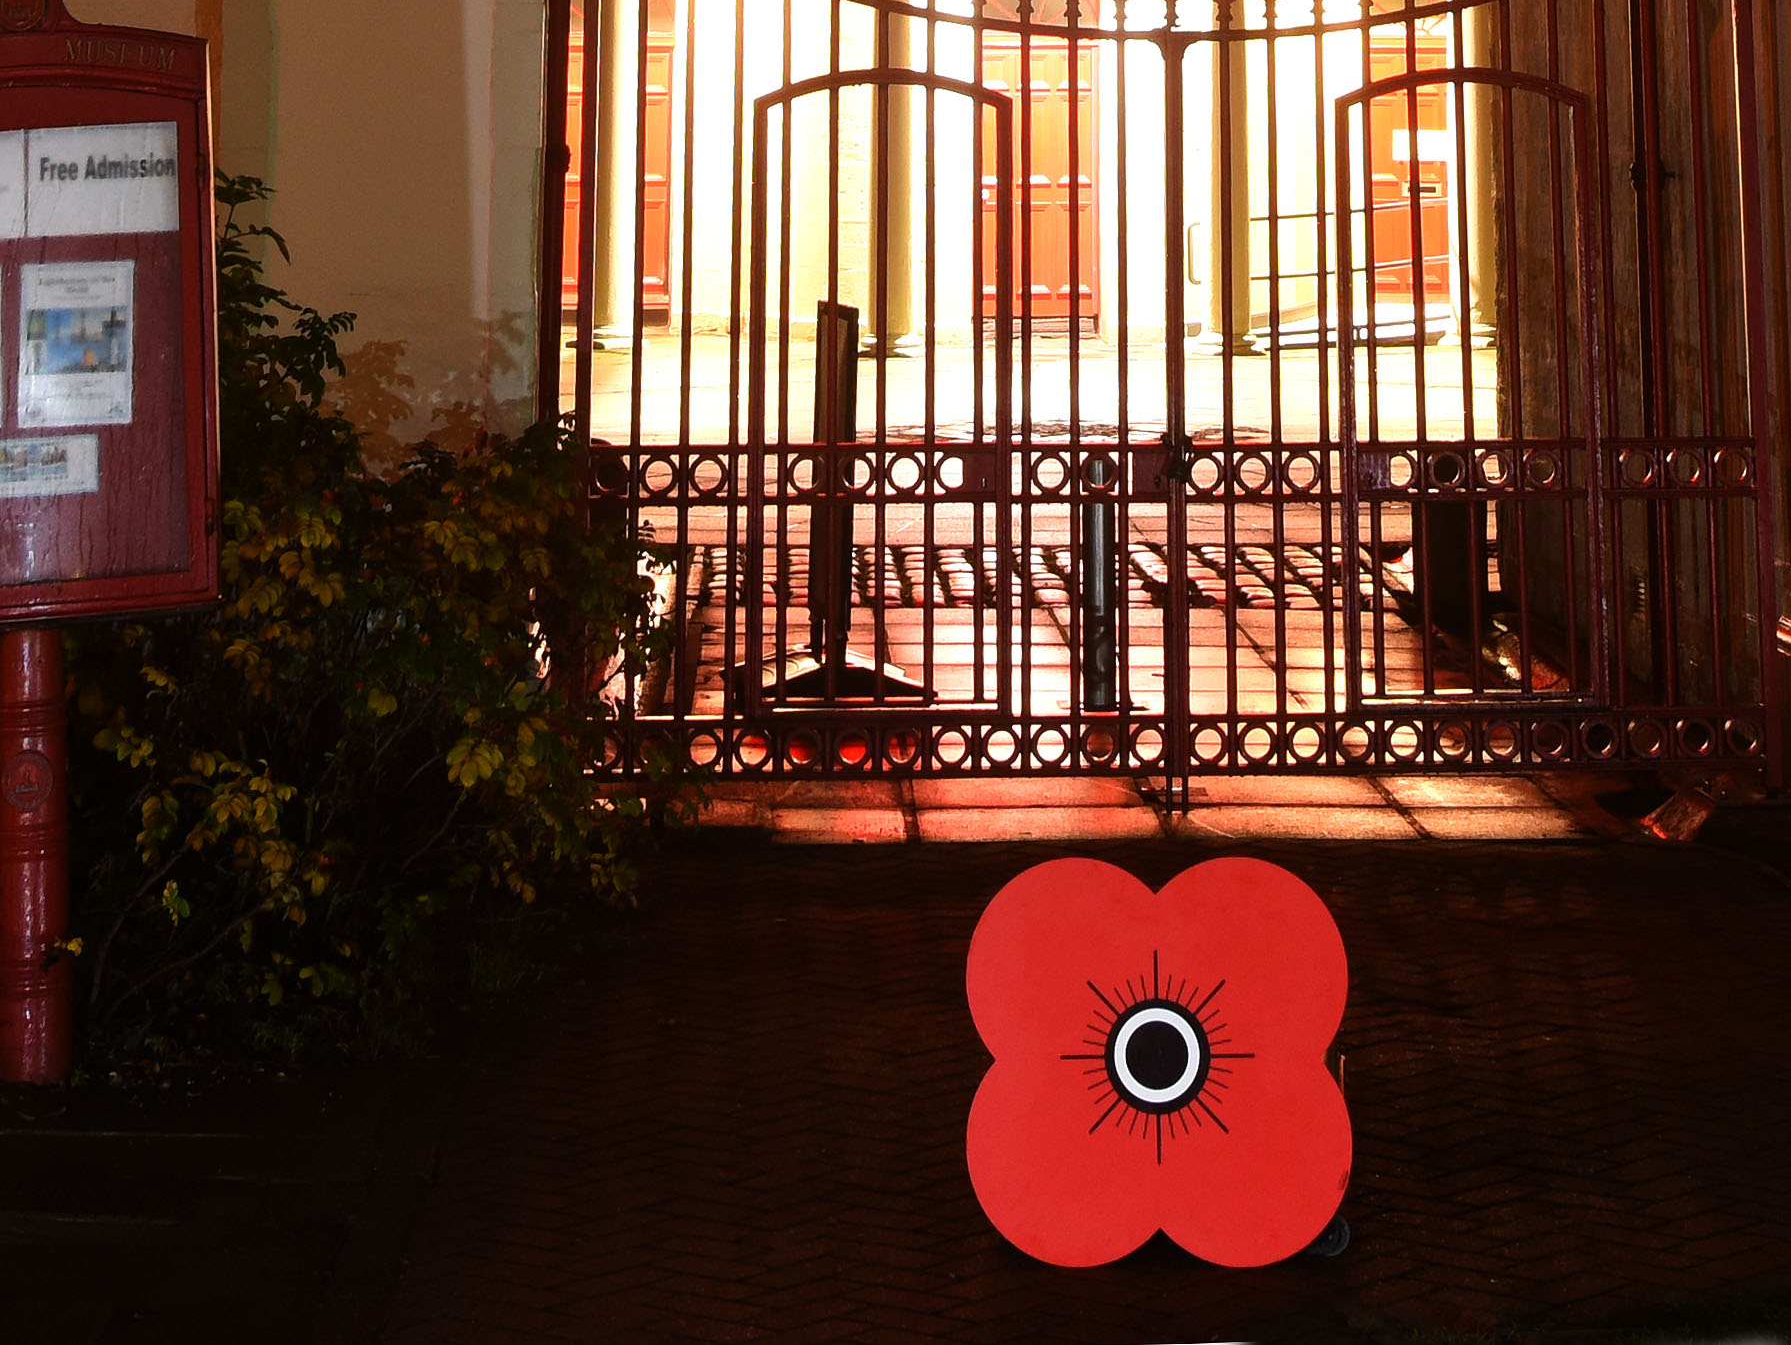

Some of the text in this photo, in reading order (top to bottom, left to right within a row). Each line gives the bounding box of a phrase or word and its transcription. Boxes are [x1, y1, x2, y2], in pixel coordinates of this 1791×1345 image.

[63, 38, 177, 70] MUSEUM
[39, 152, 176, 182] Free Admission
